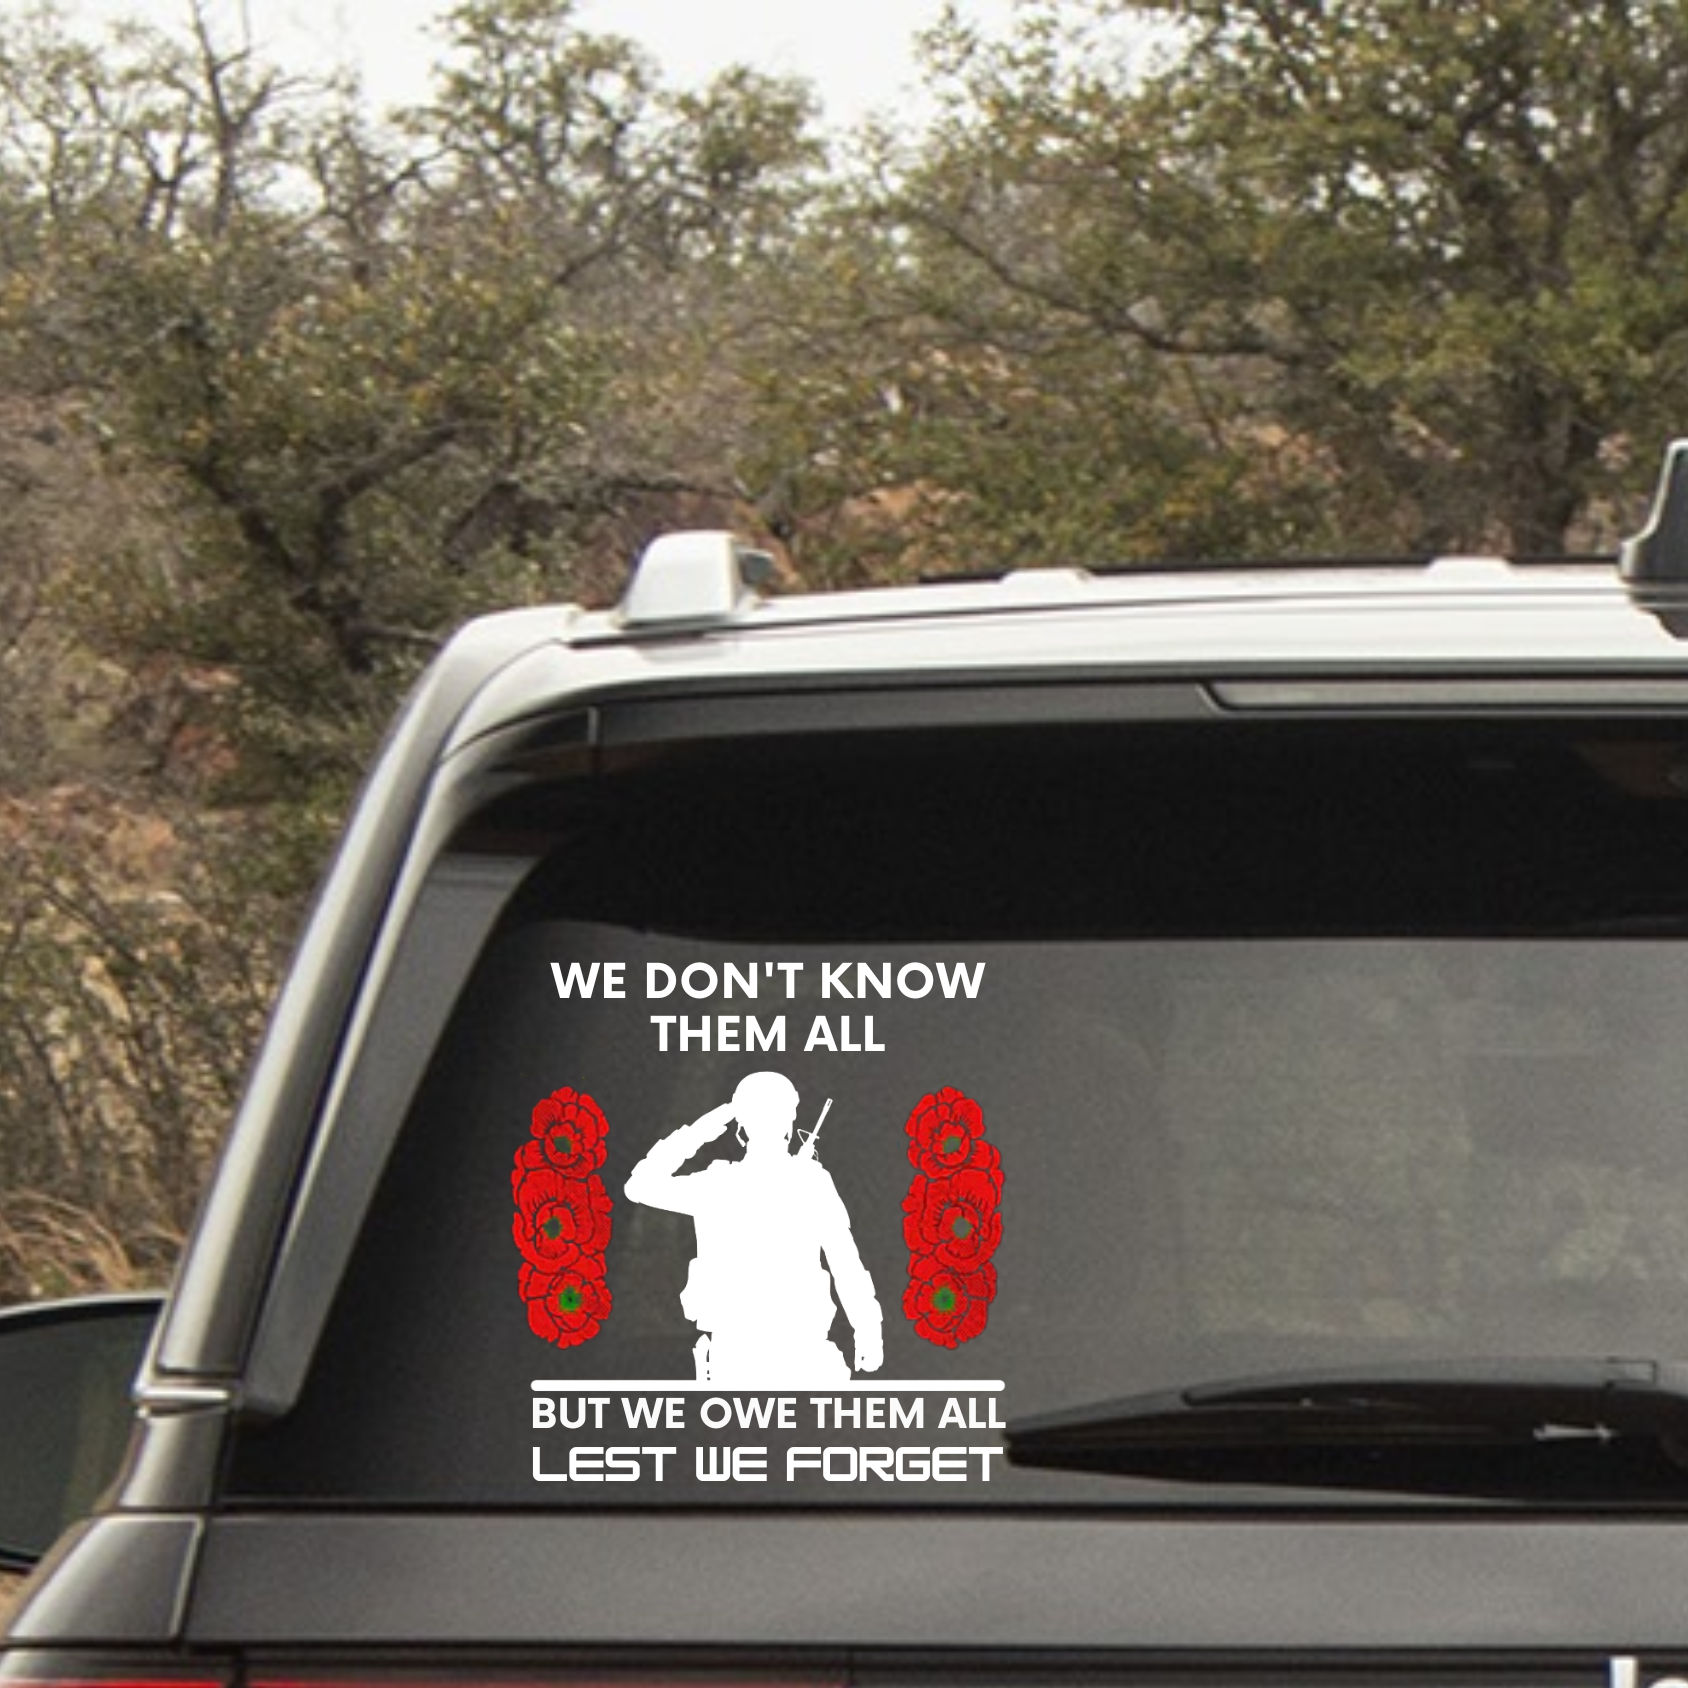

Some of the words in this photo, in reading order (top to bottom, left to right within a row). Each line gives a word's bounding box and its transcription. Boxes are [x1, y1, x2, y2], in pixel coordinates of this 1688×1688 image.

[550, 962, 626, 999] WE
[647, 961, 804, 999] DON'T
[821, 961, 986, 999] KNOW
[650, 1015, 787, 1052] THEM
[804, 1015, 885, 1052] ALL
[532, 1398, 610, 1429] BUT
[621, 1398, 685, 1429] WE
[700, 1397, 797, 1430] OWE
[810, 1398, 924, 1429] THEM
[938, 1398, 1006, 1429] ALL
[532, 1447, 677, 1482] LEST
[695, 1447, 767, 1482] WE
[786, 1447, 1004, 1482] FORGET
